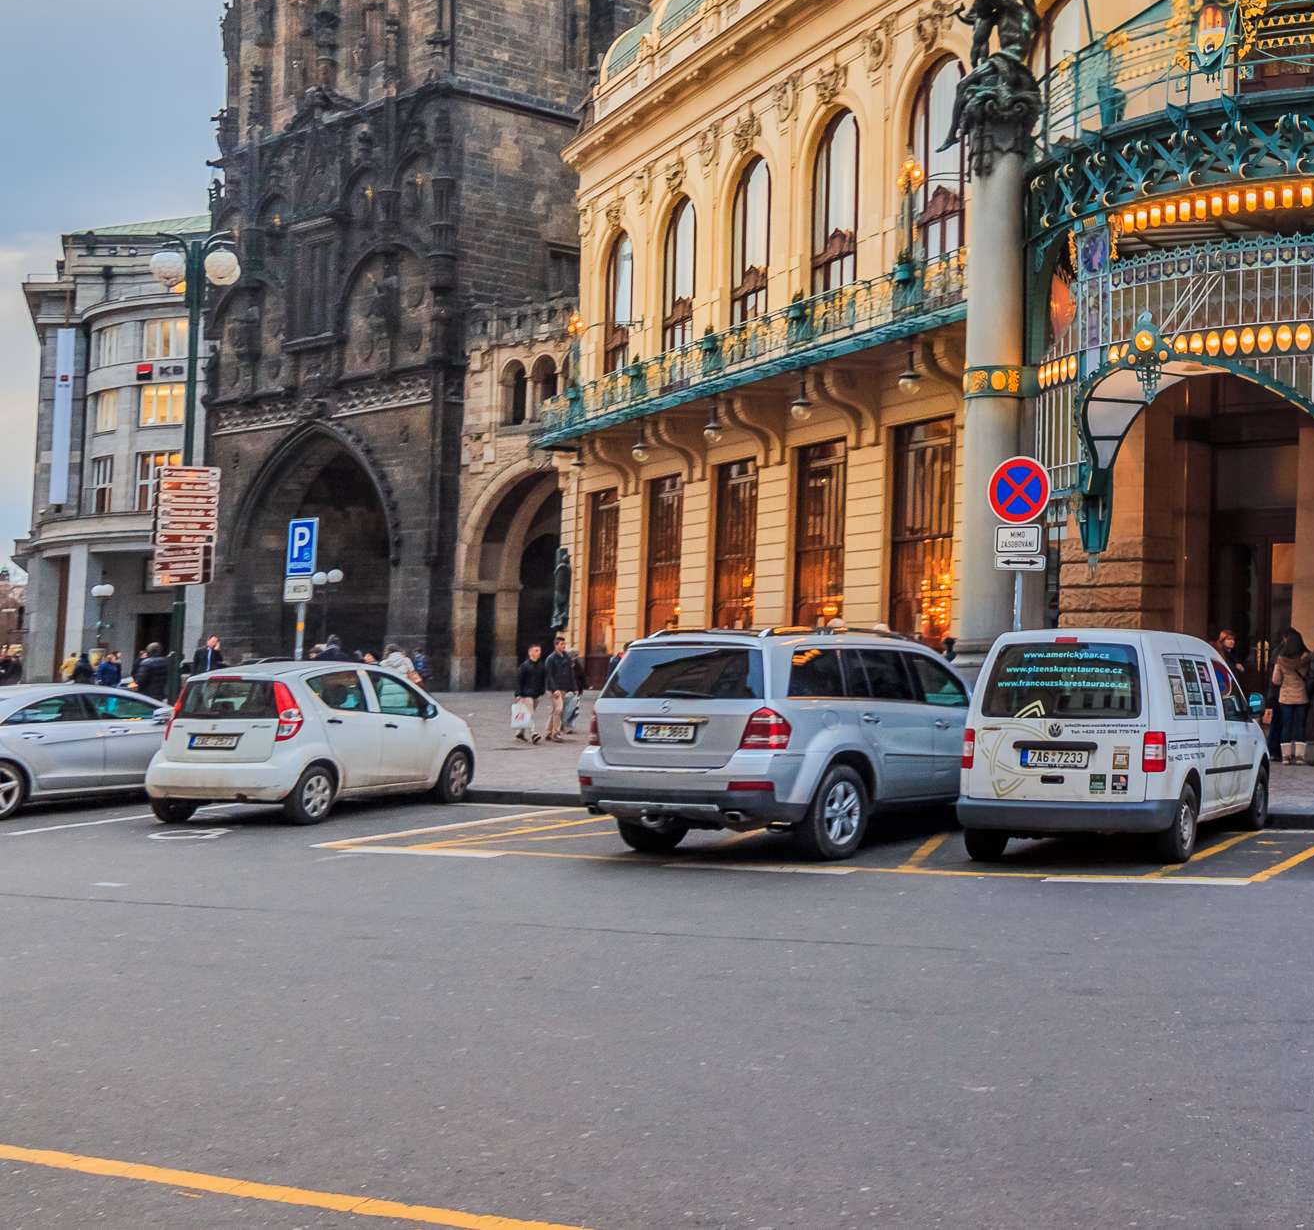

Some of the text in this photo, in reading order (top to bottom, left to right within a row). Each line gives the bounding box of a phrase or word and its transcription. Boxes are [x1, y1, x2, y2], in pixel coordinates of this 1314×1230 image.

[159, 365, 184, 376] KB
[293, 526, 310, 558] P
[1024, 651, 1109, 660] www.americkybar.cz
[1006, 666, 1123, 674] www.plzenskarestaurace.cz
[998, 680, 1128, 689] www.francouzskarestaurace.cz
[1030, 751, 1083, 763] 7A6 7233
